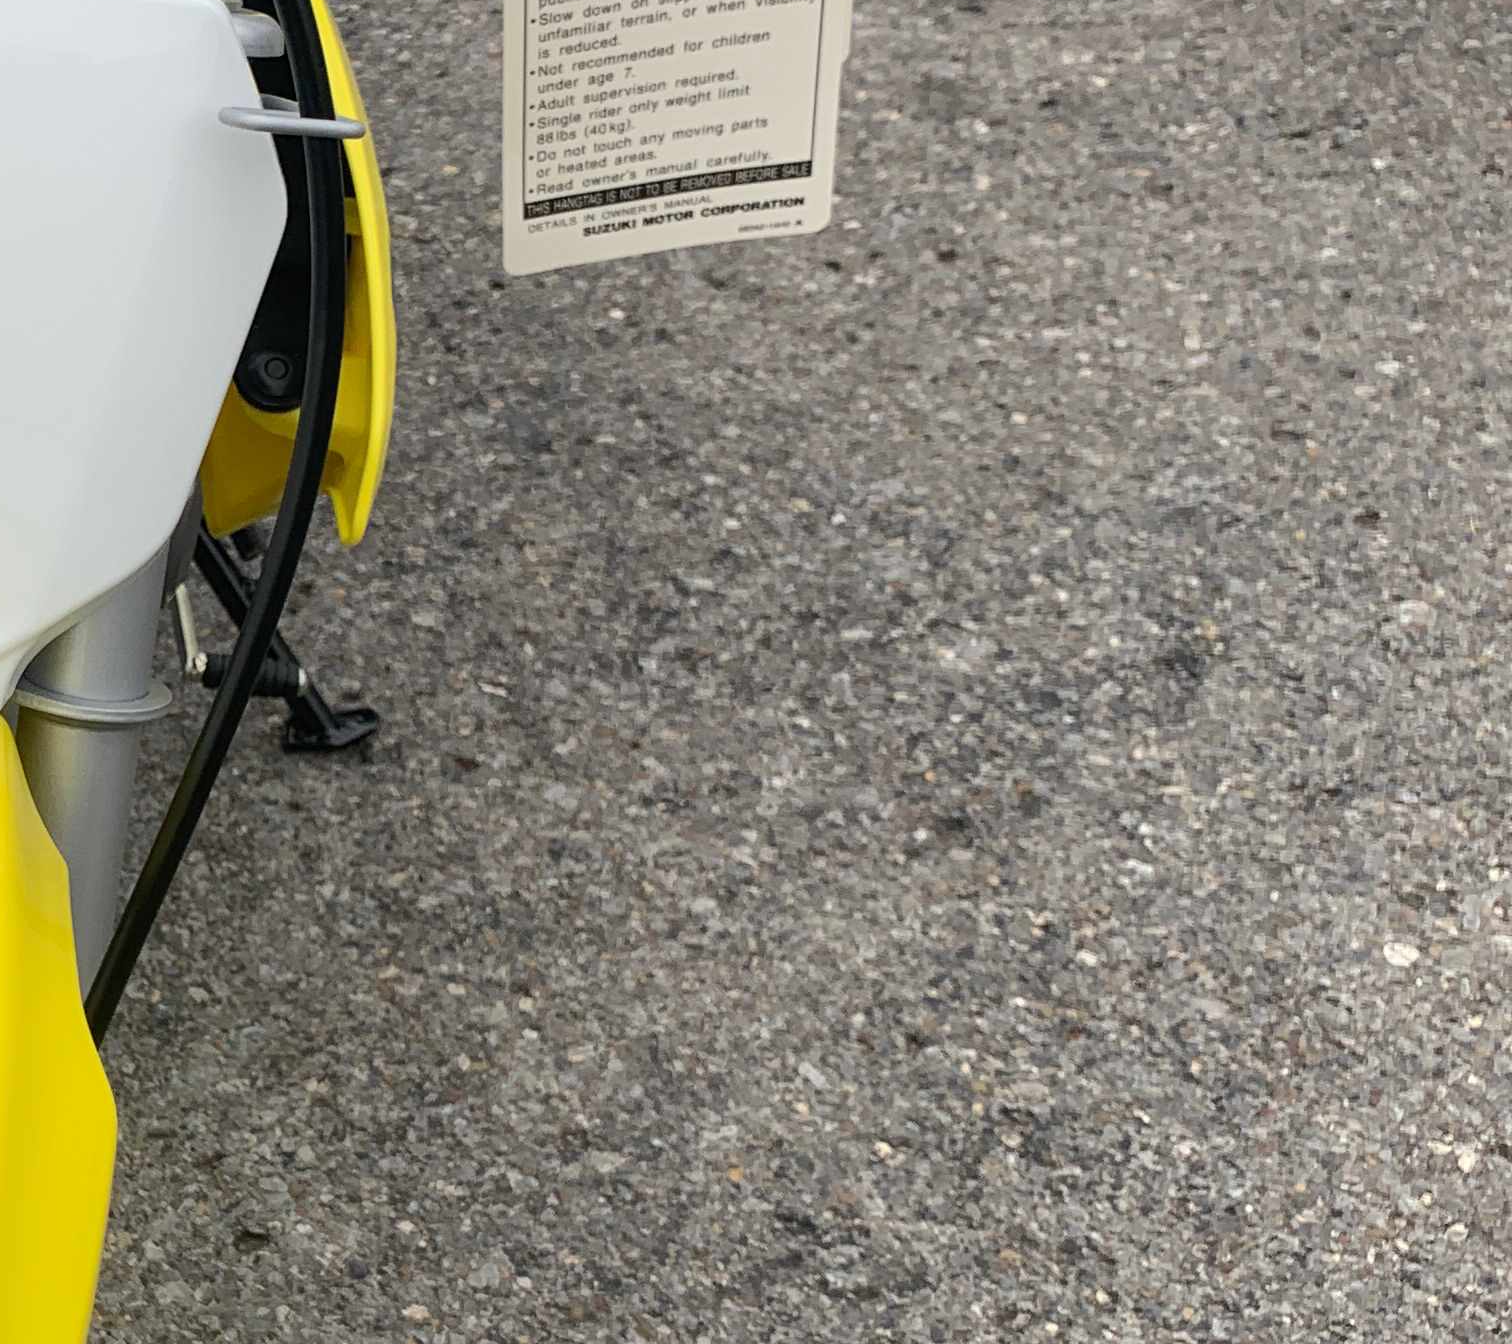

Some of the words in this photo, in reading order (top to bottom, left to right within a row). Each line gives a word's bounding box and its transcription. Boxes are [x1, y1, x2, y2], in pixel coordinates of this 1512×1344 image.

[538, 22, 611, 42] unfamiliar
[682, 7, 697, 18] or
[707, 0, 745, 14] when
[539, 12, 573, 26] Slow
[583, 3, 621, 18] down
[538, 49, 550, 59] is
[538, 64, 563, 77] Not
[572, 44, 674, 71] recommended
[684, 41, 703, 52] for
[712, 32, 770, 48] children
[538, 79, 579, 94] under
[588, 73, 614, 86] age
[538, 96, 574, 110] Adult
[584, 82, 666, 104] supervision
[537, 113, 581, 129] Single
[589, 107, 622, 119] rider
[629, 100, 658, 113] only
[665, 91, 711, 106] weight
[719, 85, 749, 99] limit
[537, 150, 556, 162] Do
[564, 145, 586, 157] not
[594, 137, 632, 152] touch
[640, 133, 665, 145] any
[672, 124, 723, 139] moving
[731, 117, 768, 133] parts
[536, 168, 550, 178] or
[558, 157, 606, 174] heated
[537, 179, 573, 194] Read
[582, 170, 636, 187] owner's
[646, 159, 697, 176] manual
[620, 187, 642, 200] NOT
[645, 184, 659, 198] TO
[664, 196, 712, 209] MANUAL
[583, 220, 636, 236] SUZUKI
[643, 211, 693, 225] MOTOR
[701, 198, 804, 217] CORPORATION
